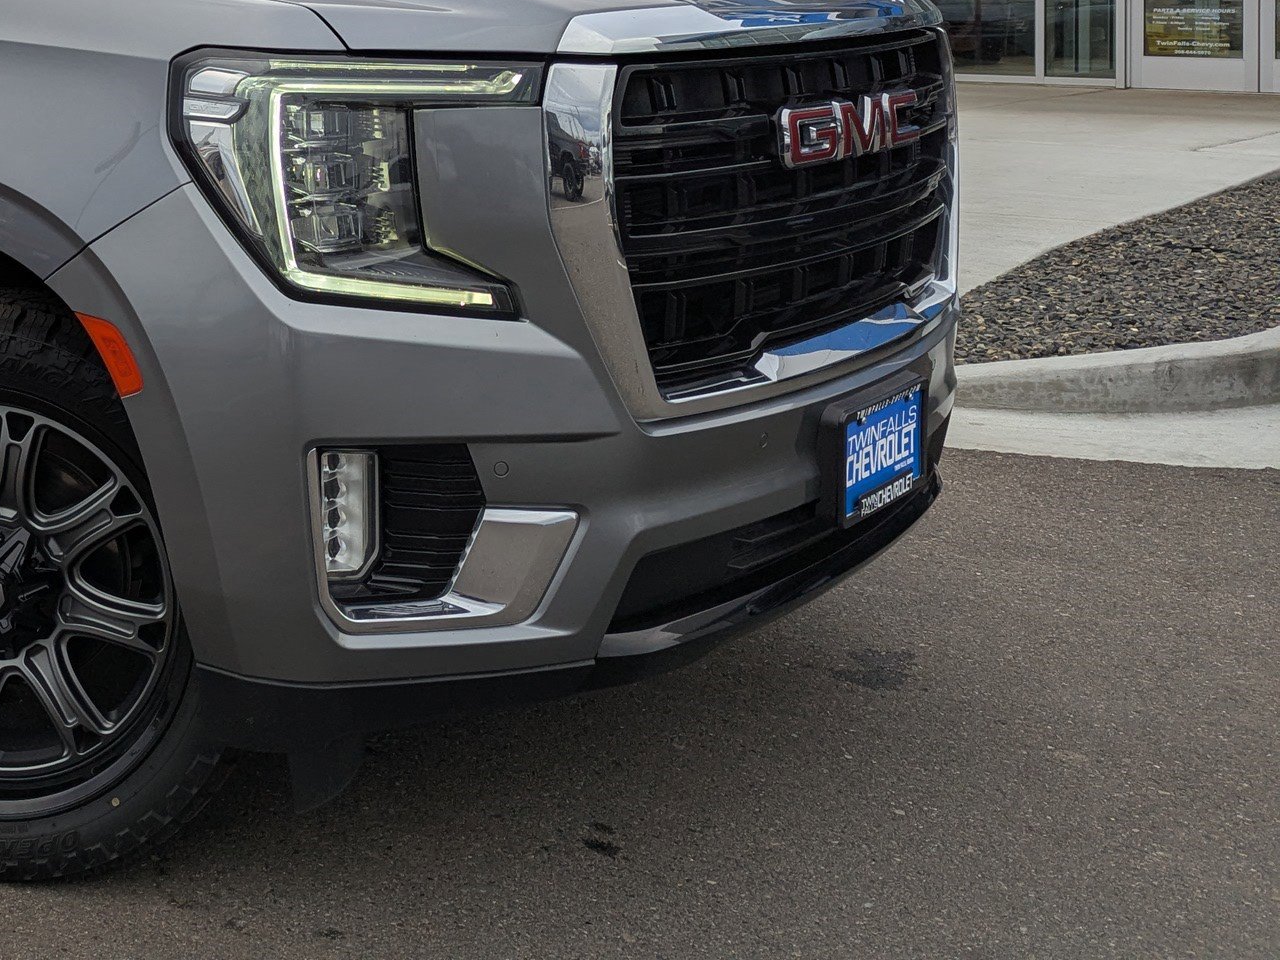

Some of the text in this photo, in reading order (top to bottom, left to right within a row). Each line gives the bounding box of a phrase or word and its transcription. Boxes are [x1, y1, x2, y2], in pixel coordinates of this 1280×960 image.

[777, 90, 920, 169] GMC
[846, 422, 917, 488] CHEVROLET
[848, 405, 917, 455] TWINFALLS
[877, 472, 914, 508] CHEVROLET
